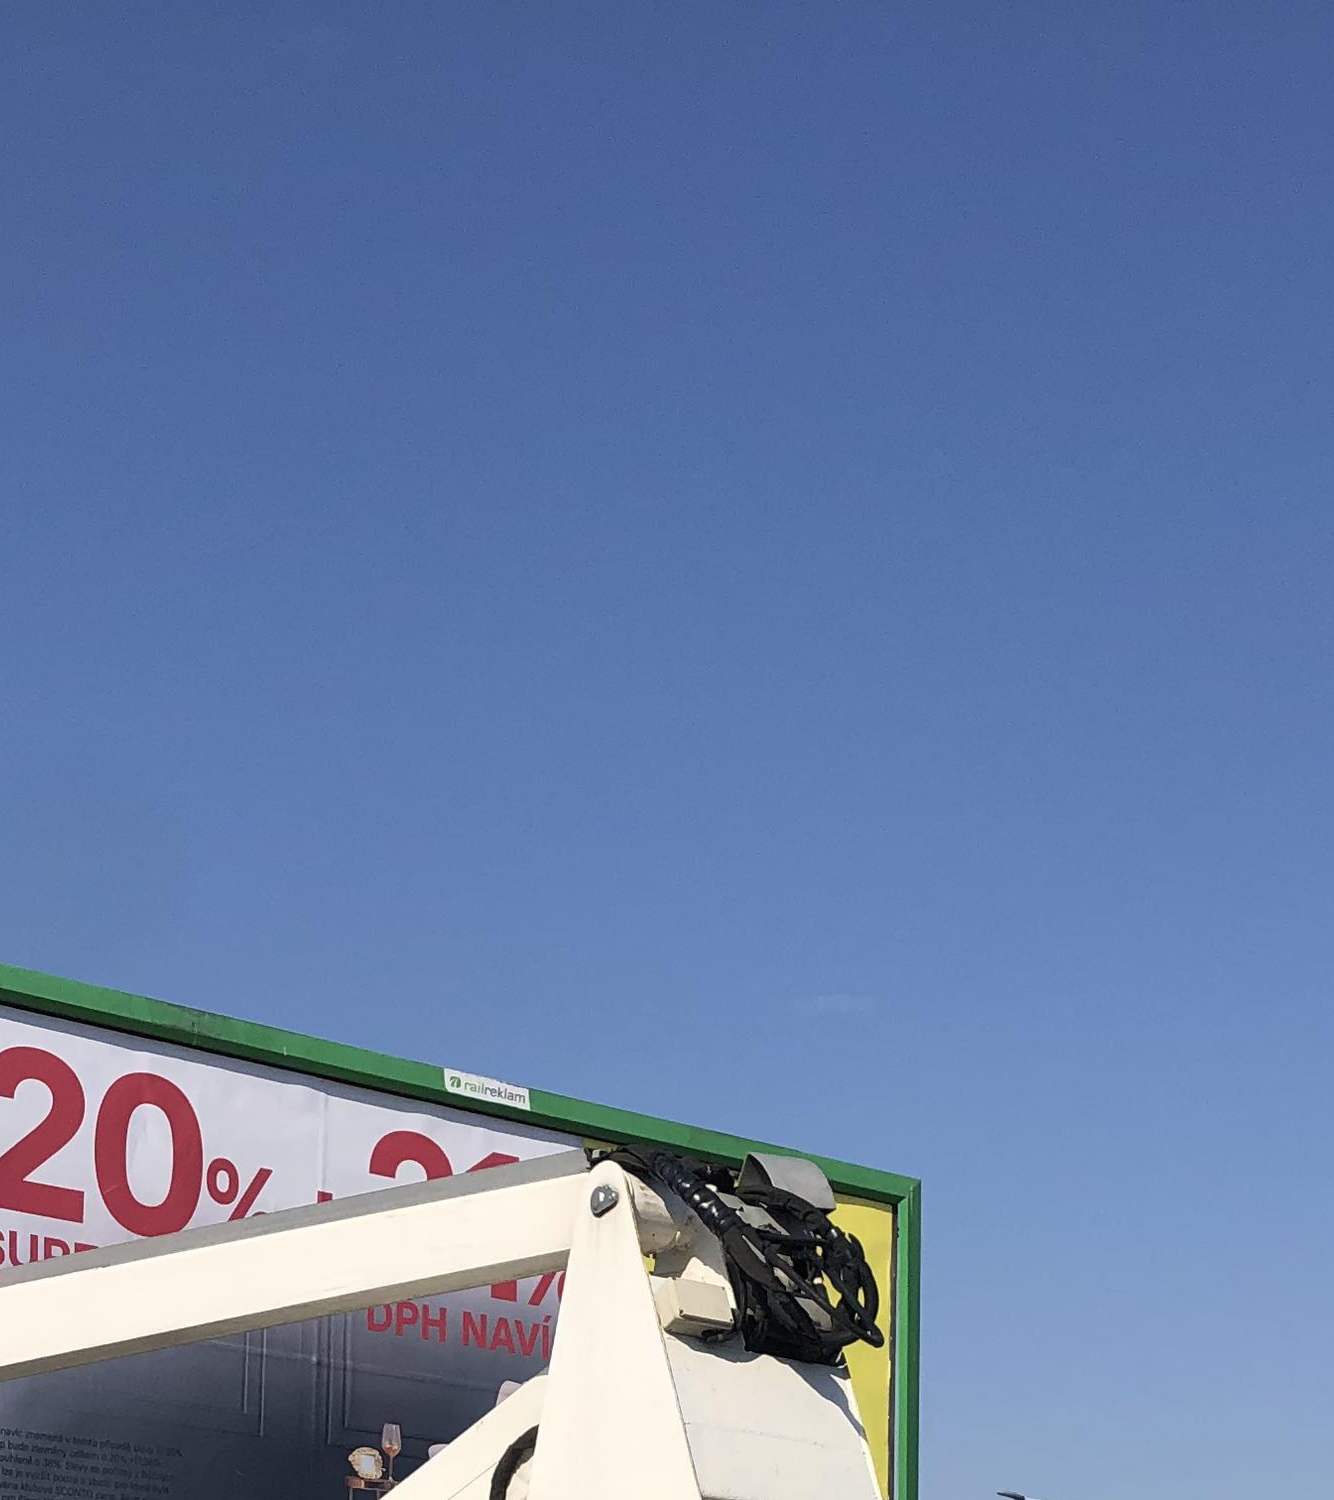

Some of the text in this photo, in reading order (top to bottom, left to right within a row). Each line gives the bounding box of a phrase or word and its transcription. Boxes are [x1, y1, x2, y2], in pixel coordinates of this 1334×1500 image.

[464, 1082, 526, 1104] railreklam
[367, 1301, 553, 1361] DPH NAVÍ
